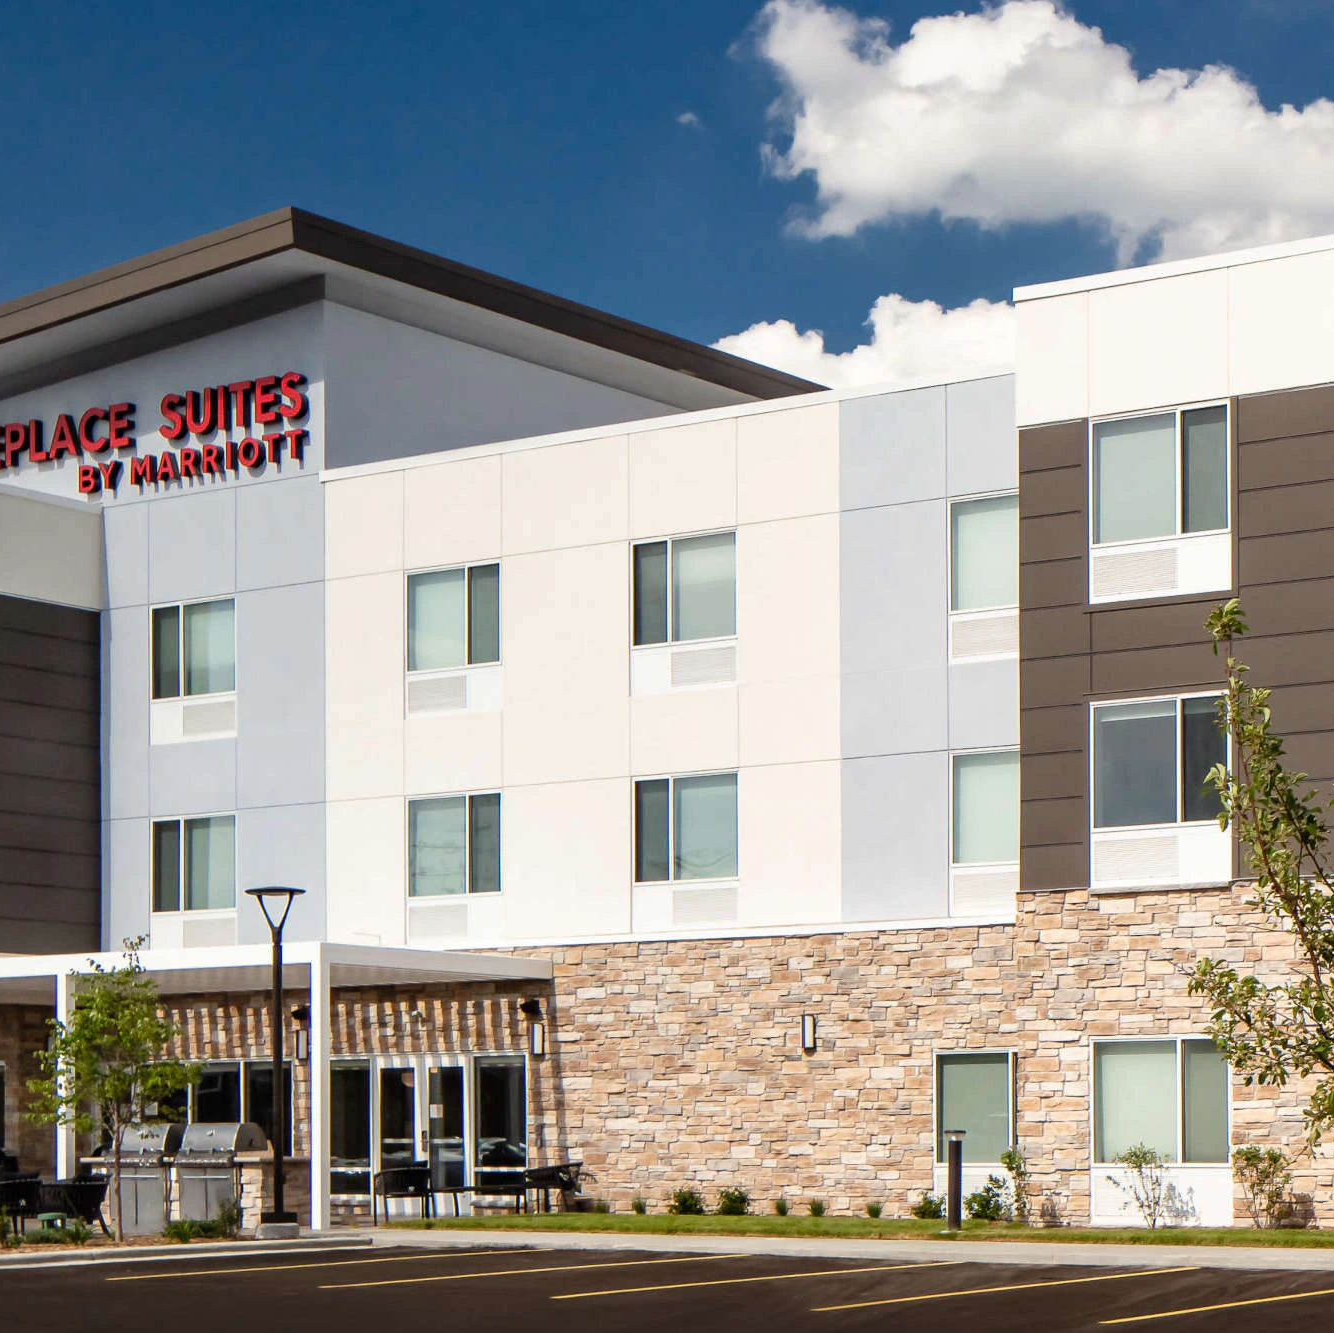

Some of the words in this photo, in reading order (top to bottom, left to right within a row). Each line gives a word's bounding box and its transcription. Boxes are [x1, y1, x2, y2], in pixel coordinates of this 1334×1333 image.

[158, 371, 308, 440] SUITES
[78, 460, 120, 494] BY
[131, 428, 307, 486] MARRIOTT
